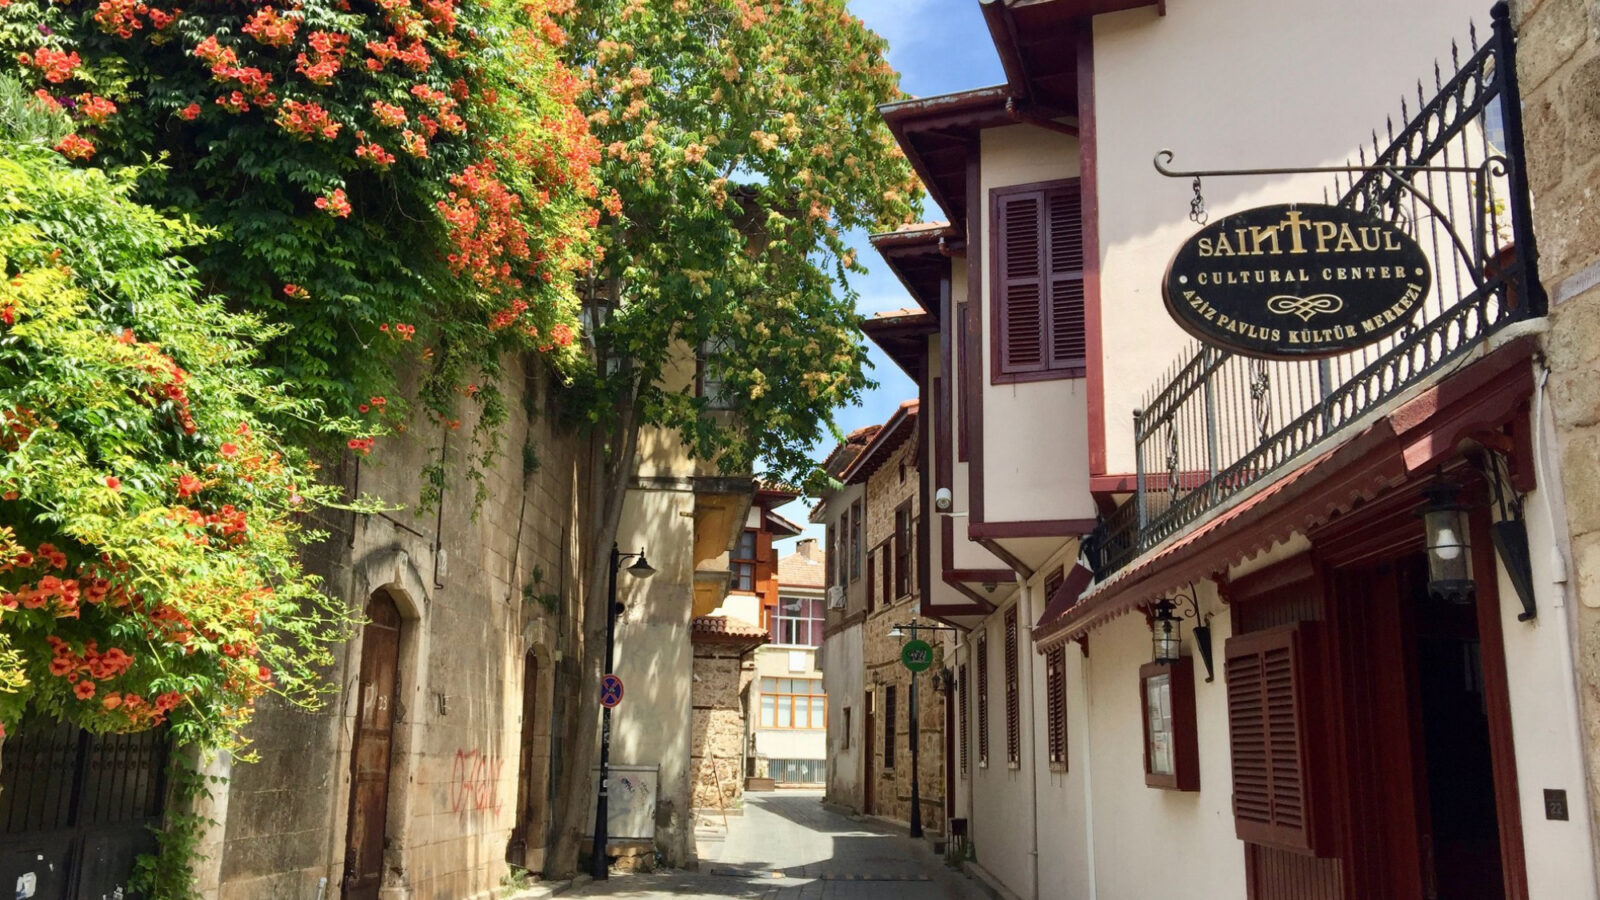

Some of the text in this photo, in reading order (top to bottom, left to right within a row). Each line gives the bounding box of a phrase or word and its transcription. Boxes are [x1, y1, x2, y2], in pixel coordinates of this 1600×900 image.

[1198, 210, 1402, 257] SAINT PAUL
[1197, 265, 1407, 285] CULTURAL CENTER
[1183, 282, 1424, 344] AZİZ PAVLUS KÜLTÜR MERKEZİ
